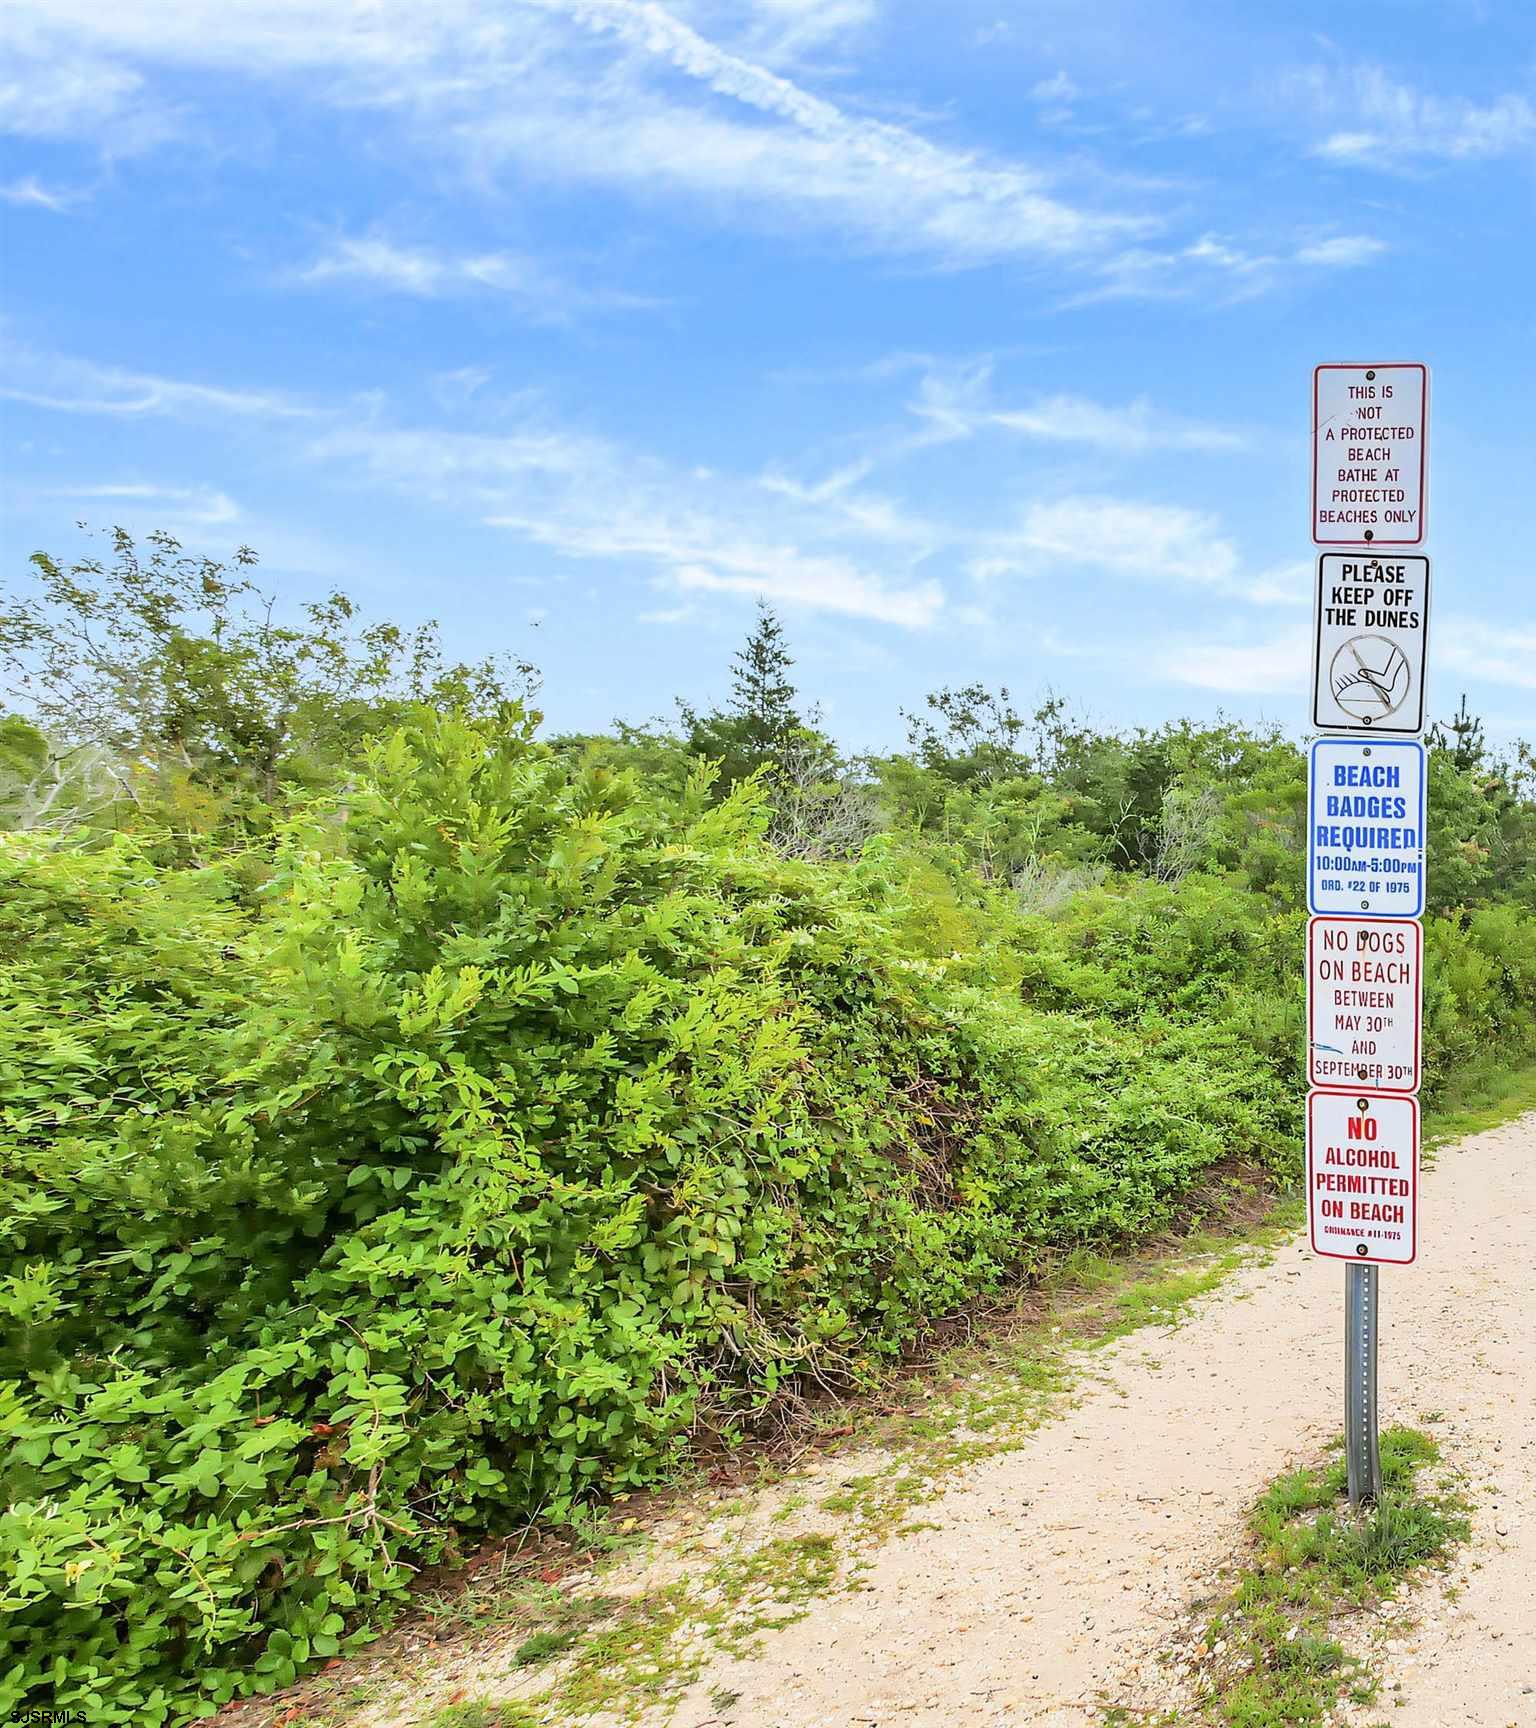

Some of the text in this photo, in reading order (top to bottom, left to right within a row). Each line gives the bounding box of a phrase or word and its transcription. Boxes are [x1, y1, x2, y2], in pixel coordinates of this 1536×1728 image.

[1348, 386, 1393, 399] THIS IS
[1358, 406, 1382, 419] NOT
[1326, 427, 1414, 441] A PROTECTED
[1348, 448, 1390, 461] BEACH
[1338, 469, 1400, 482] BATHE AT
[1332, 490, 1404, 502] PROTECTED
[1319, 510, 1416, 523] BEACHES ONLY
[1342, 564, 1405, 583] PLEASE
[1332, 587, 1414, 606] KEEP OFF
[1325, 608, 1419, 629] THE DUNES
[1334, 765, 1400, 788] BEACH
[1327, 796, 1406, 819] BADGES
[1317, 826, 1416, 852] REQUIRED
[1321, 879, 1344, 891] ORD.
[1369, 881, 1381, 892] OF
[1386, 882, 1410, 893] 1975
[1324, 930, 1405, 954] NO DOGS
[1320, 959, 1410, 984] ON BEACH
[1334, 990, 1394, 1008] BETWEEN
[1335, 1015, 1361, 1031] MAY
[1351, 1040, 1376, 1055] AND
[1348, 1117, 1377, 1141] NO
[1325, 1147, 1400, 1169] ALCOHOL
[1316, 1173, 1409, 1197] PERMITTED
[1321, 1199, 1404, 1224] ON BEACH
